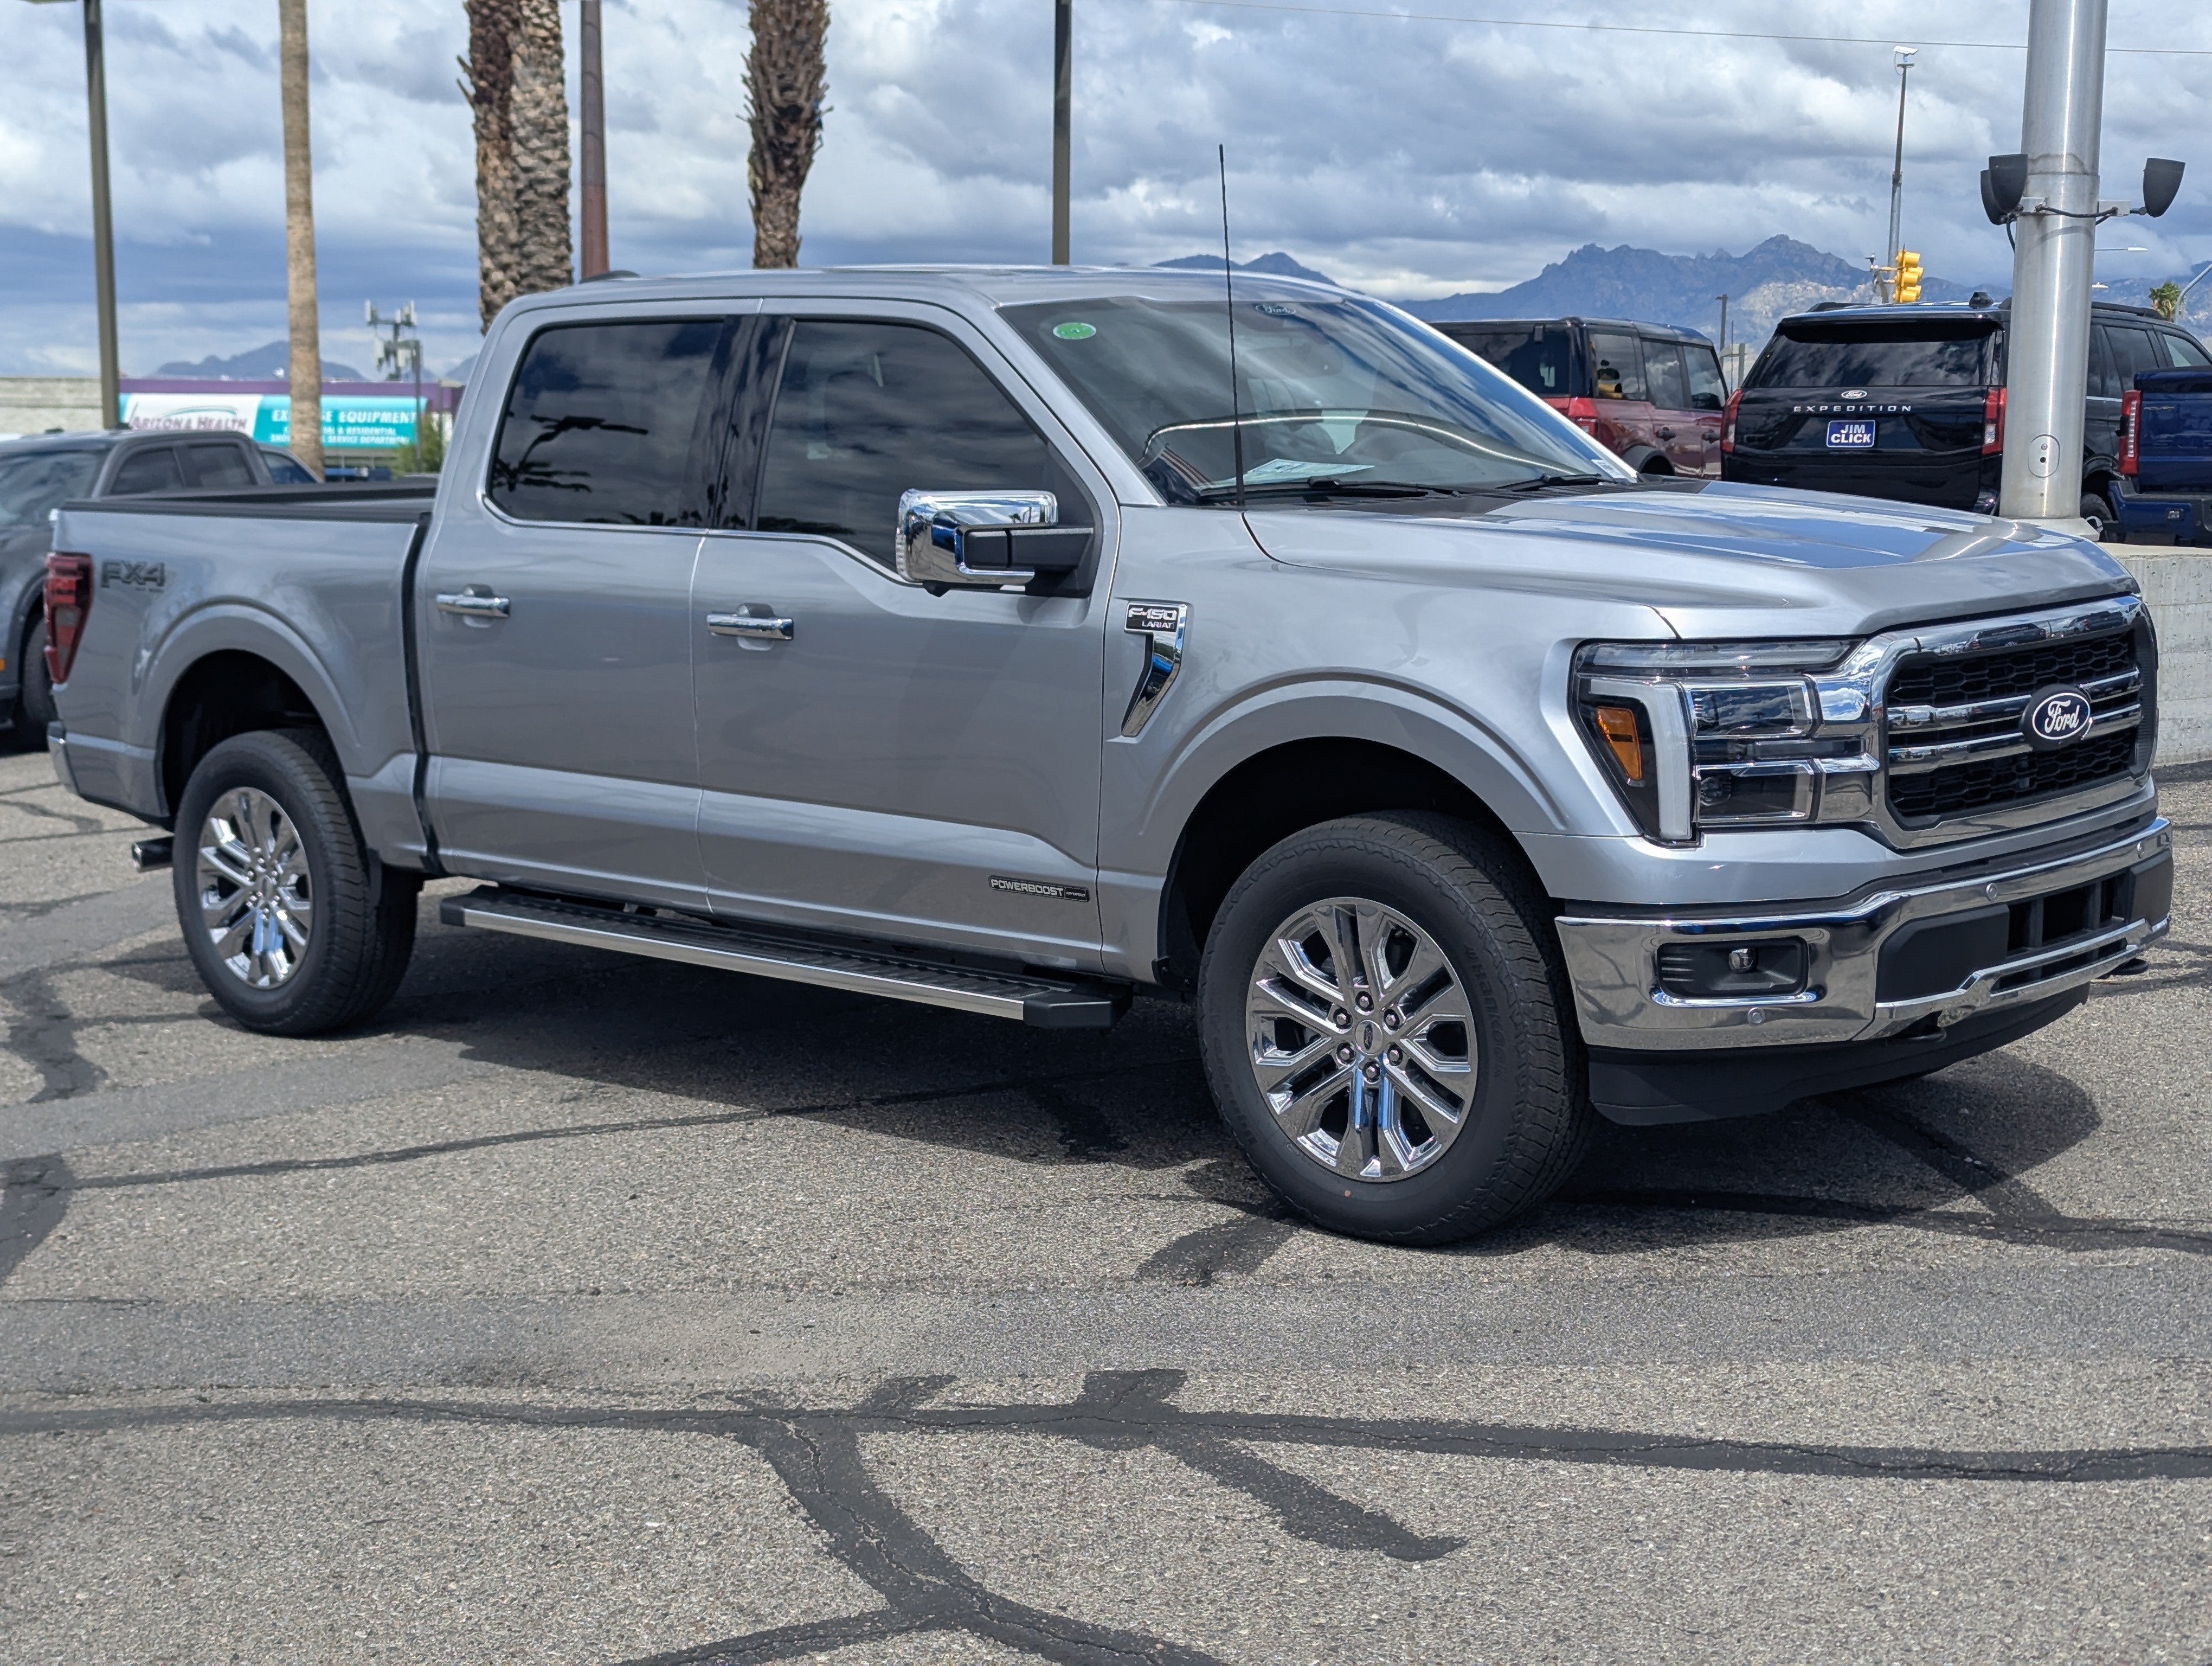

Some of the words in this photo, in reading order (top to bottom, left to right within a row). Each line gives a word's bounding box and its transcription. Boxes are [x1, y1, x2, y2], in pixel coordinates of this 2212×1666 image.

[197, 415, 248, 430] HEALTH
[339, 411, 416, 424] EQUIPMENT
[1840, 424, 1866, 433] JIM
[1831, 433, 1872, 443] CLICK
[101, 560, 165, 588] FX4
[1128, 607, 1177, 621] F-150
[1141, 620, 1174, 629] LARIAT
[2043, 699, 2081, 734] Ford
[990, 879, 1064, 896] POWERBOOST
